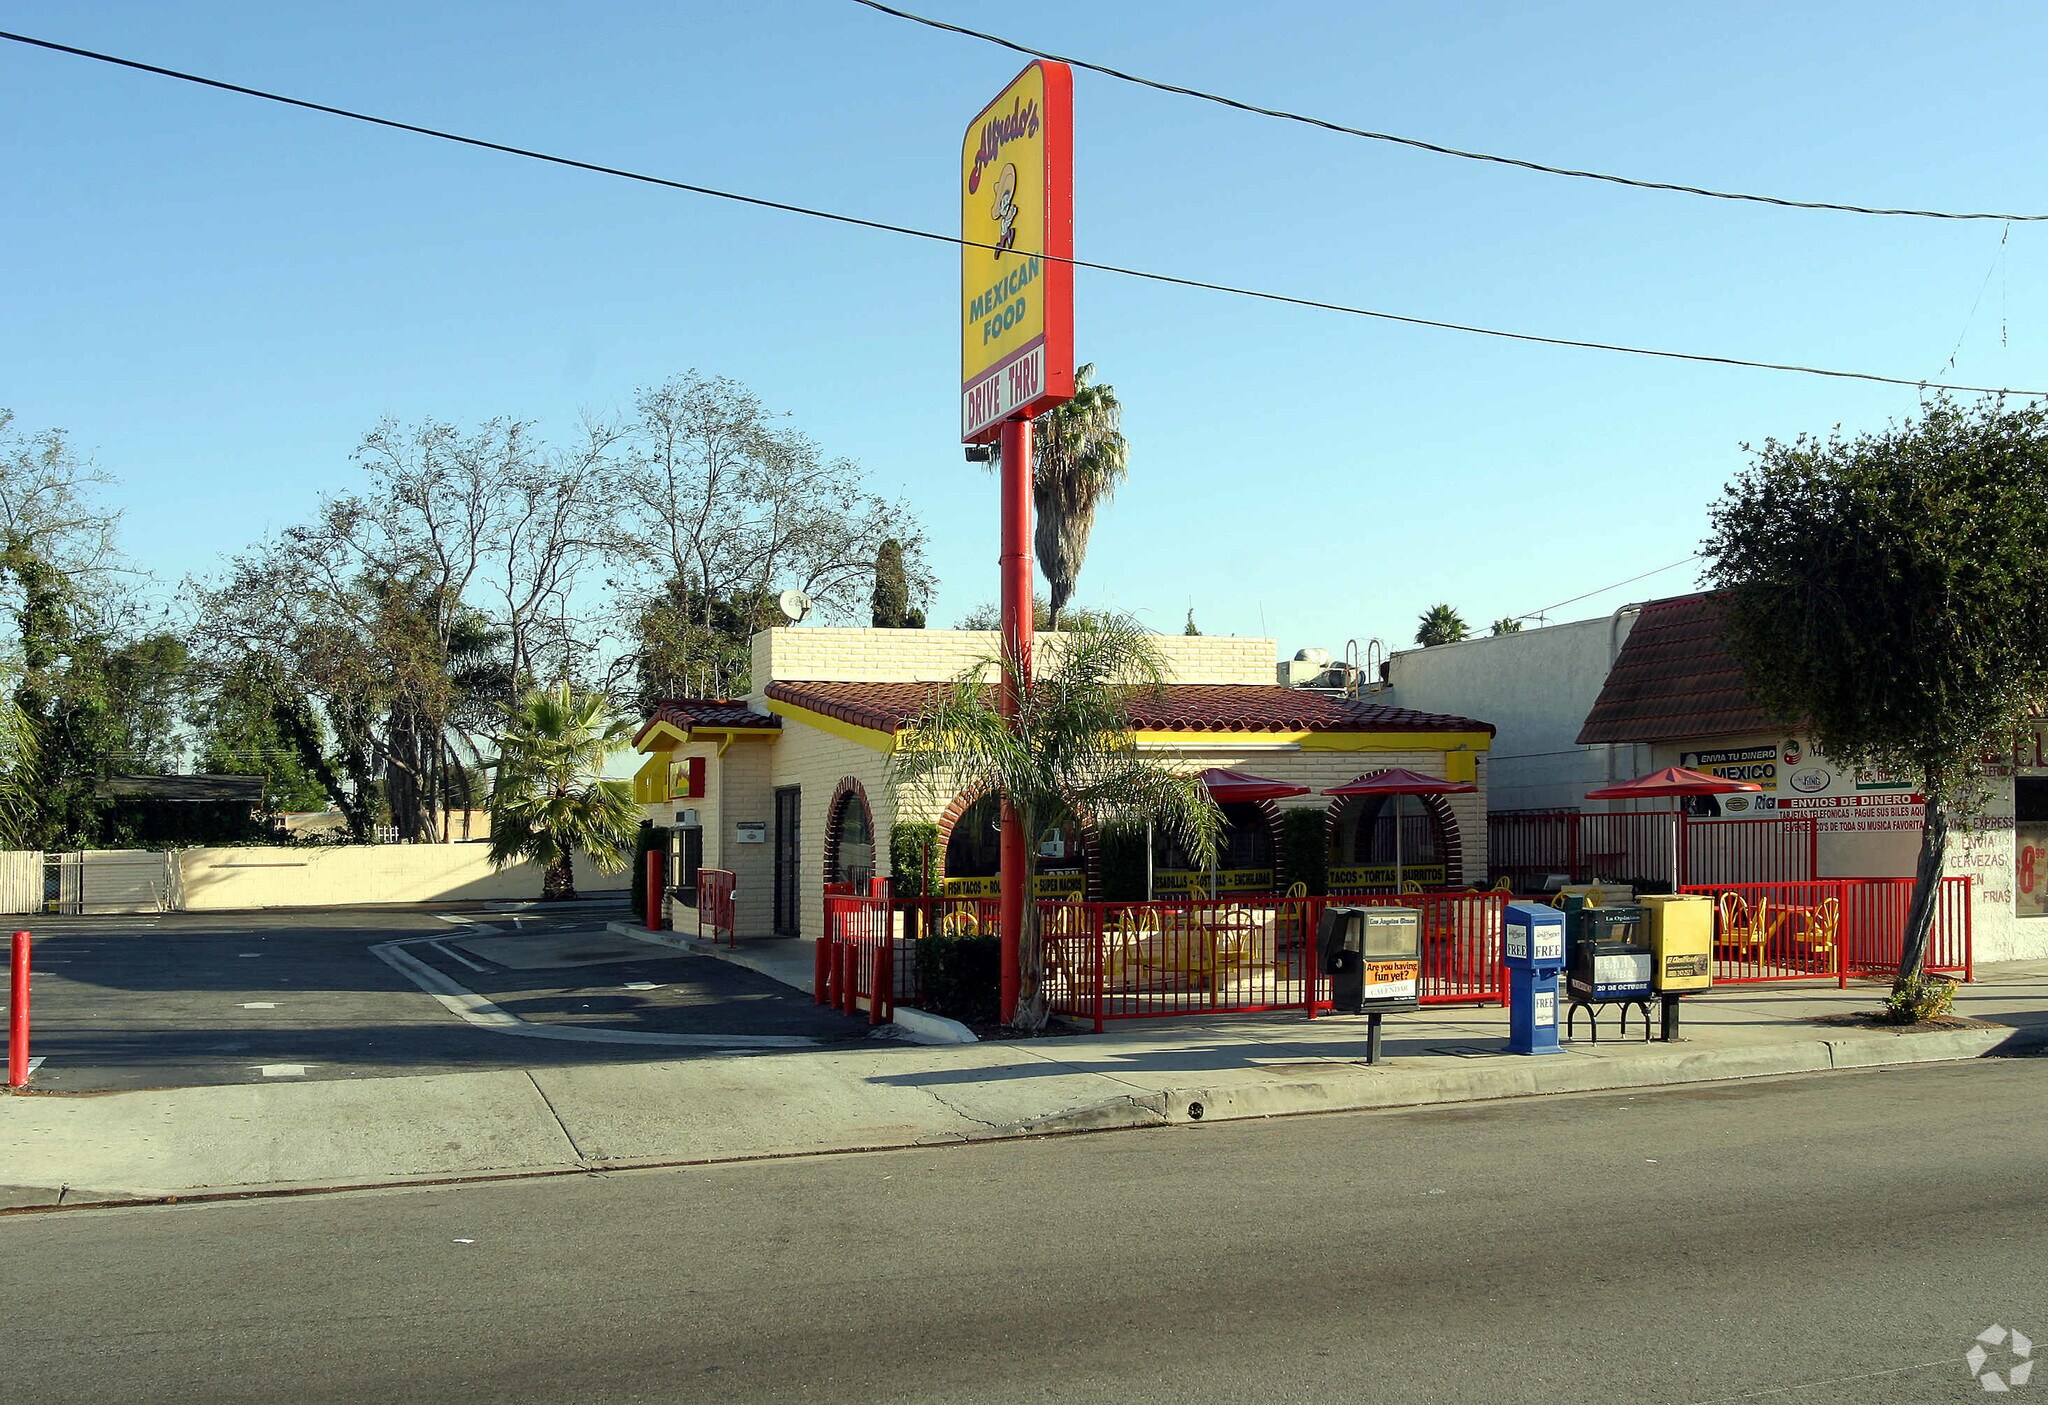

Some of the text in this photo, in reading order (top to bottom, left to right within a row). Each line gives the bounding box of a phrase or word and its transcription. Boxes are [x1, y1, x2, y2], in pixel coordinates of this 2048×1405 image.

[969, 96, 1039, 194] Alfredo's
[969, 251, 1040, 325] MEXICAN
[983, 297, 1026, 346] FOOD
[1008, 350, 1039, 407] THRU
[968, 373, 1000, 431] DRIVE
[1701, 750, 1776, 763] ENVIA TU DINERO
[1712, 763, 1776, 780] MEXICO
[1754, 794, 1776, 810] Ria
[1791, 795, 1912, 808] ENVIOS DE DINERO
[1809, 809, 1850, 819] TELEFONICAS
[1855, 808, 1876, 818] PAGUE
[1877, 807, 1890, 817] SUS
[1830, 822, 1839, 831] DE
[1840, 821, 1857, 831] TODA
[1858, 821, 1866, 830] SU
[1868, 820, 1891, 830] MUSICA
[1892, 819, 1924, 830] FAVORITA
[1973, 816, 2014, 829] EXPRESS
[1961, 835, 1995, 850] ENVIA
[1950, 854, 2005, 868] CERVEZAS
[1330, 868, 1443, 884] TACOS TORTAS BURRITOS
[947, 881, 962, 895] FISH
[962, 880, 981, 894] TACOS
[1039, 878, 1058, 892] SUPER
[1059, 877, 1082, 892] NACHOS
[1983, 890, 2011, 903] FRIAS
[1507, 943, 1527, 957] FREE
[1535, 945, 1561, 958] FREE
[1367, 962, 1417, 972] Are you having
[1374, 970, 1409, 982] fun yet?
[1371, 985, 1408, 996] CALENDAR
[1597, 984, 1606, 992] 20
[1618, 983, 1647, 991] OCTUBRE
[1536, 998, 1554, 1009] FREE
